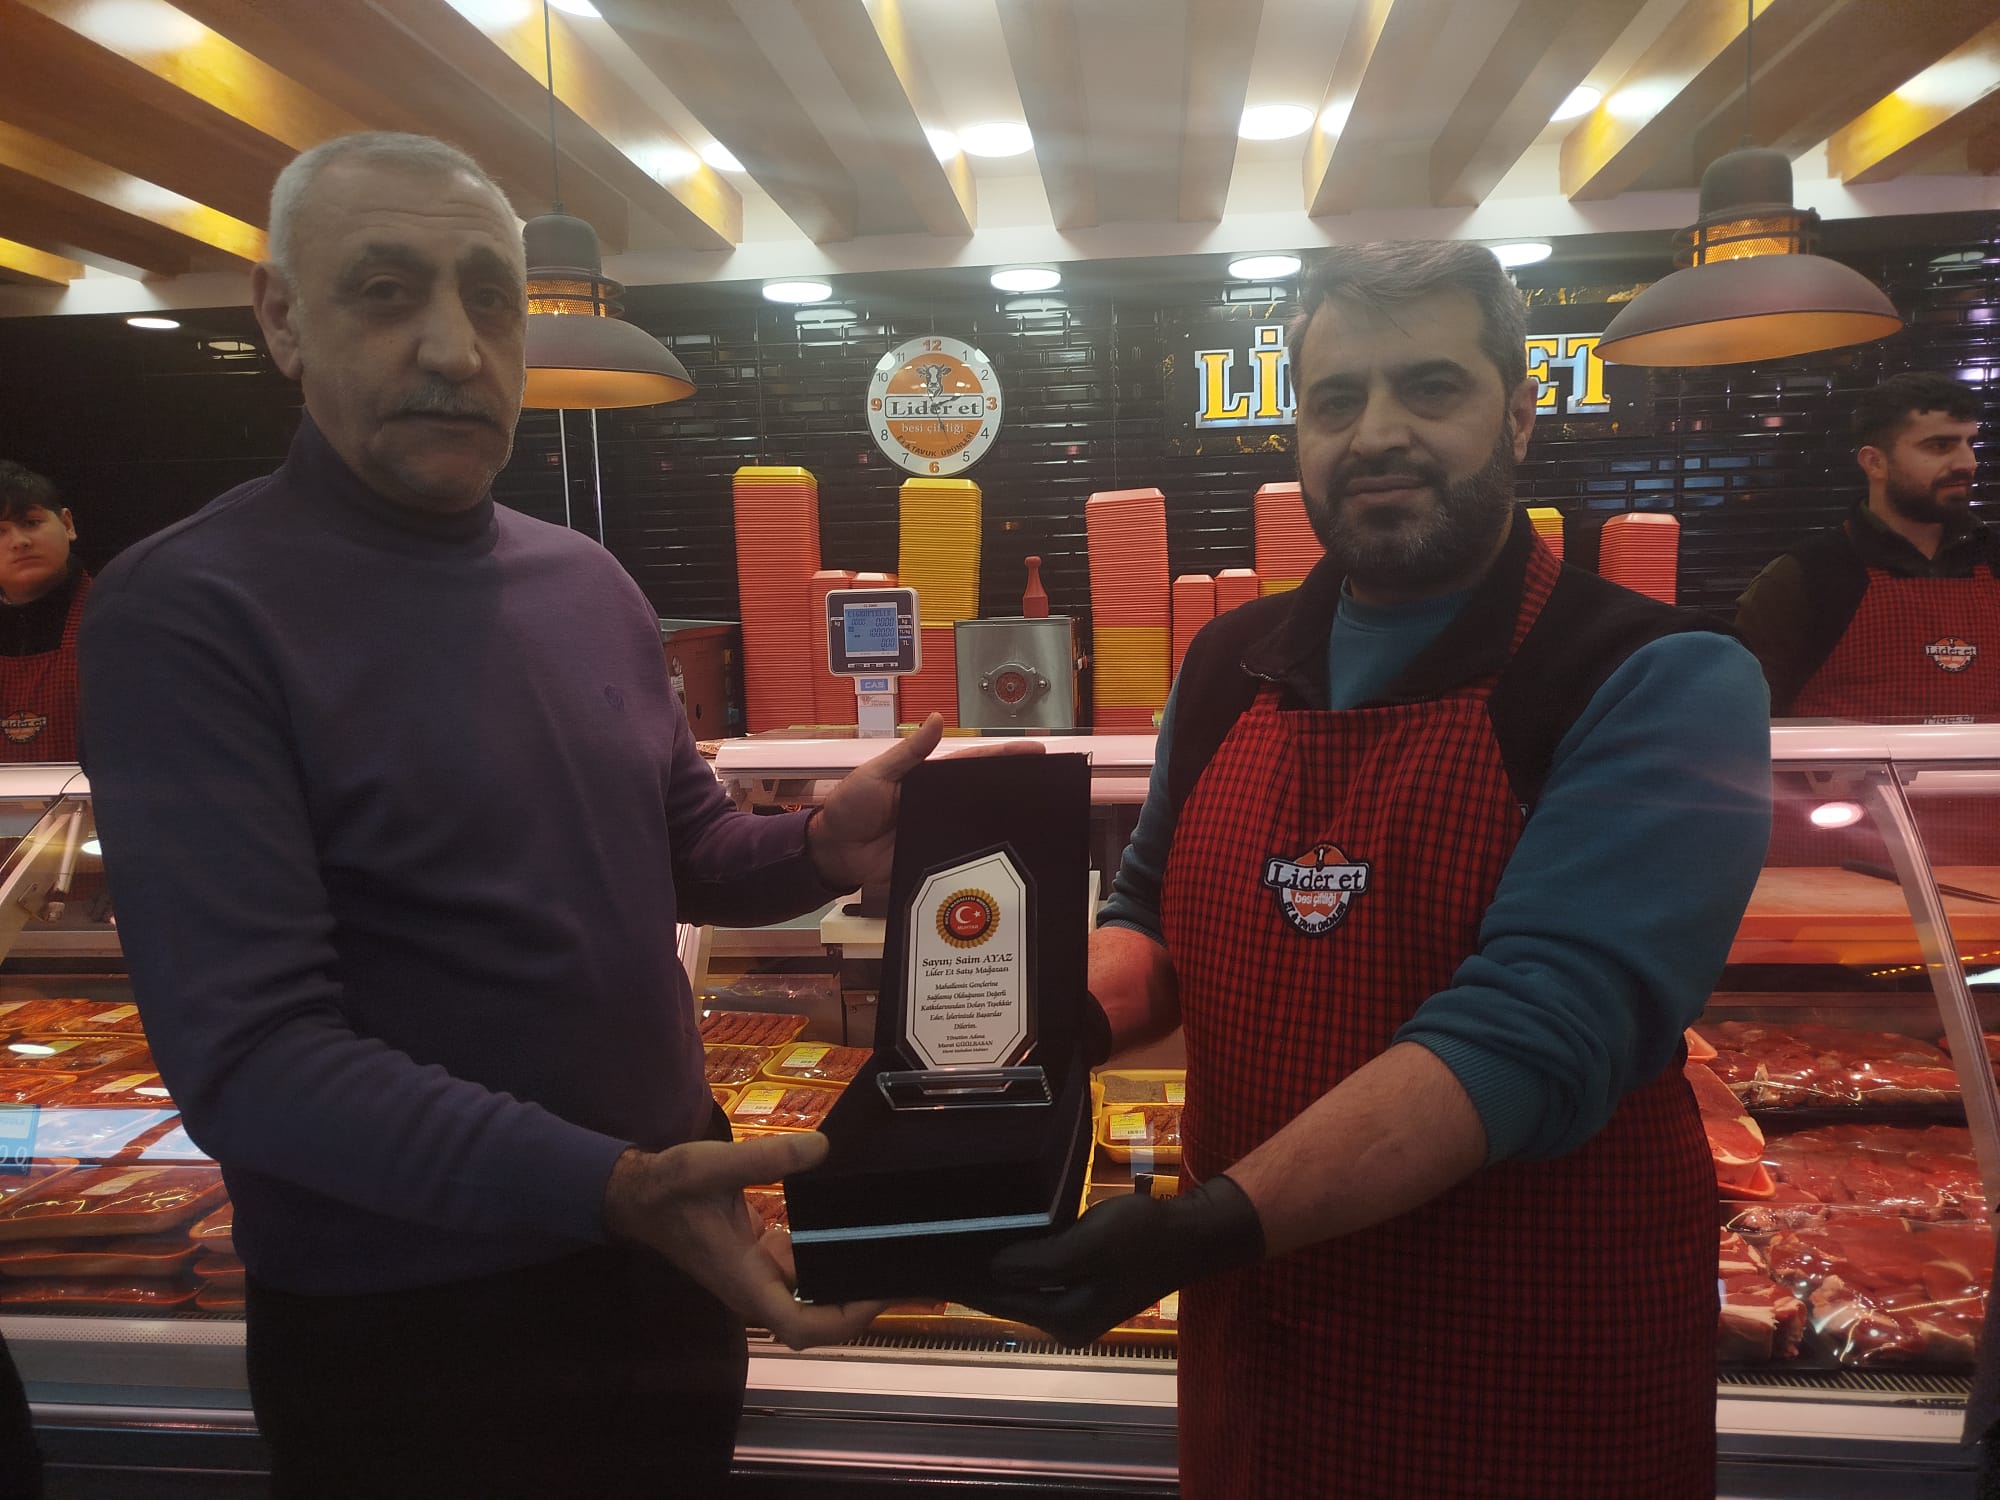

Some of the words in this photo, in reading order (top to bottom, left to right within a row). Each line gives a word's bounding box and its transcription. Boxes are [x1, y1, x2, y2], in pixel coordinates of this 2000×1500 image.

[922, 339, 942, 352] 12
[896, 352, 906, 362] 11
[962, 350, 968, 361] 1
[876, 372, 889, 383] 10
[980, 369, 989, 381] 2
[870, 397, 882, 411] 9
[890, 400, 953, 416] Lider
[957, 402, 980, 416] et
[986, 396, 998, 411] 3
[880, 429, 889, 441] 8
[980, 427, 990, 440] 4
[910, 446, 937, 457] TAVUK
[962, 450, 970, 463] 5
[901, 452, 910, 465] 7
[928, 461, 940, 474] 6
[864, 681, 885, 690] CAS
[1269, 863, 1334, 889] Lider
[1338, 870, 1363, 890] et
[1295, 892, 1313, 904] besi
[955, 955, 980, 965] Saim
[982, 953, 1014, 963] AYAZ
[925, 969, 944, 977] Lider
[945, 968, 954, 976] Et
[956, 967, 973, 975] Satış
